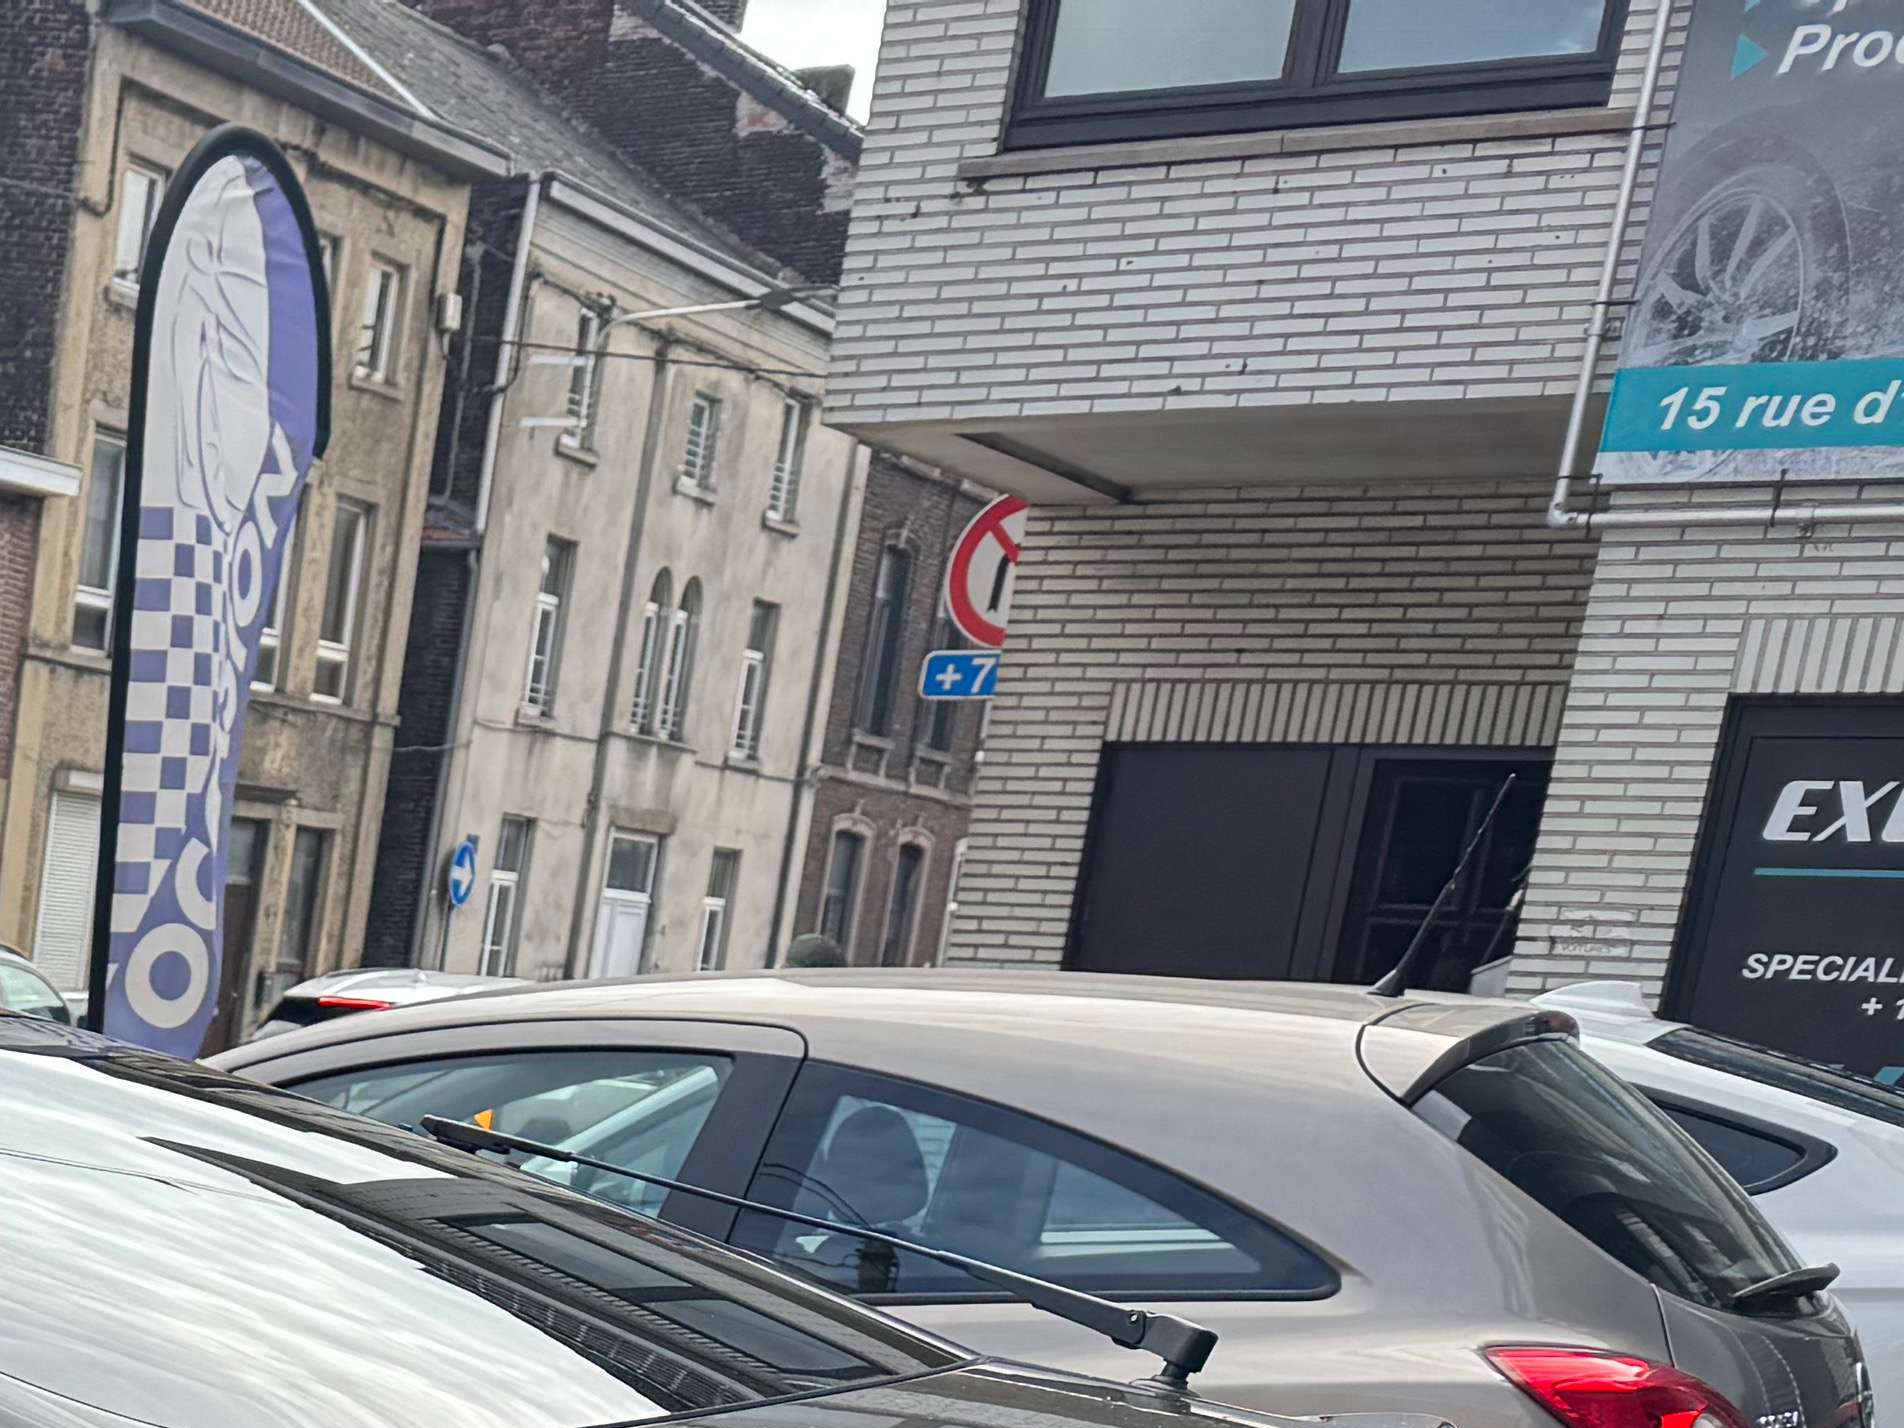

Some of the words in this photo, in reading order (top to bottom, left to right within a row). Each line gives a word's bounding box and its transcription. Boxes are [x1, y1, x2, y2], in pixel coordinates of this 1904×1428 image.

[1776, 24, 1904, 77] Pro
[1659, 387, 1728, 432] 15
[1735, 392, 1837, 430] rue
[970, 657, 997, 694] 7
